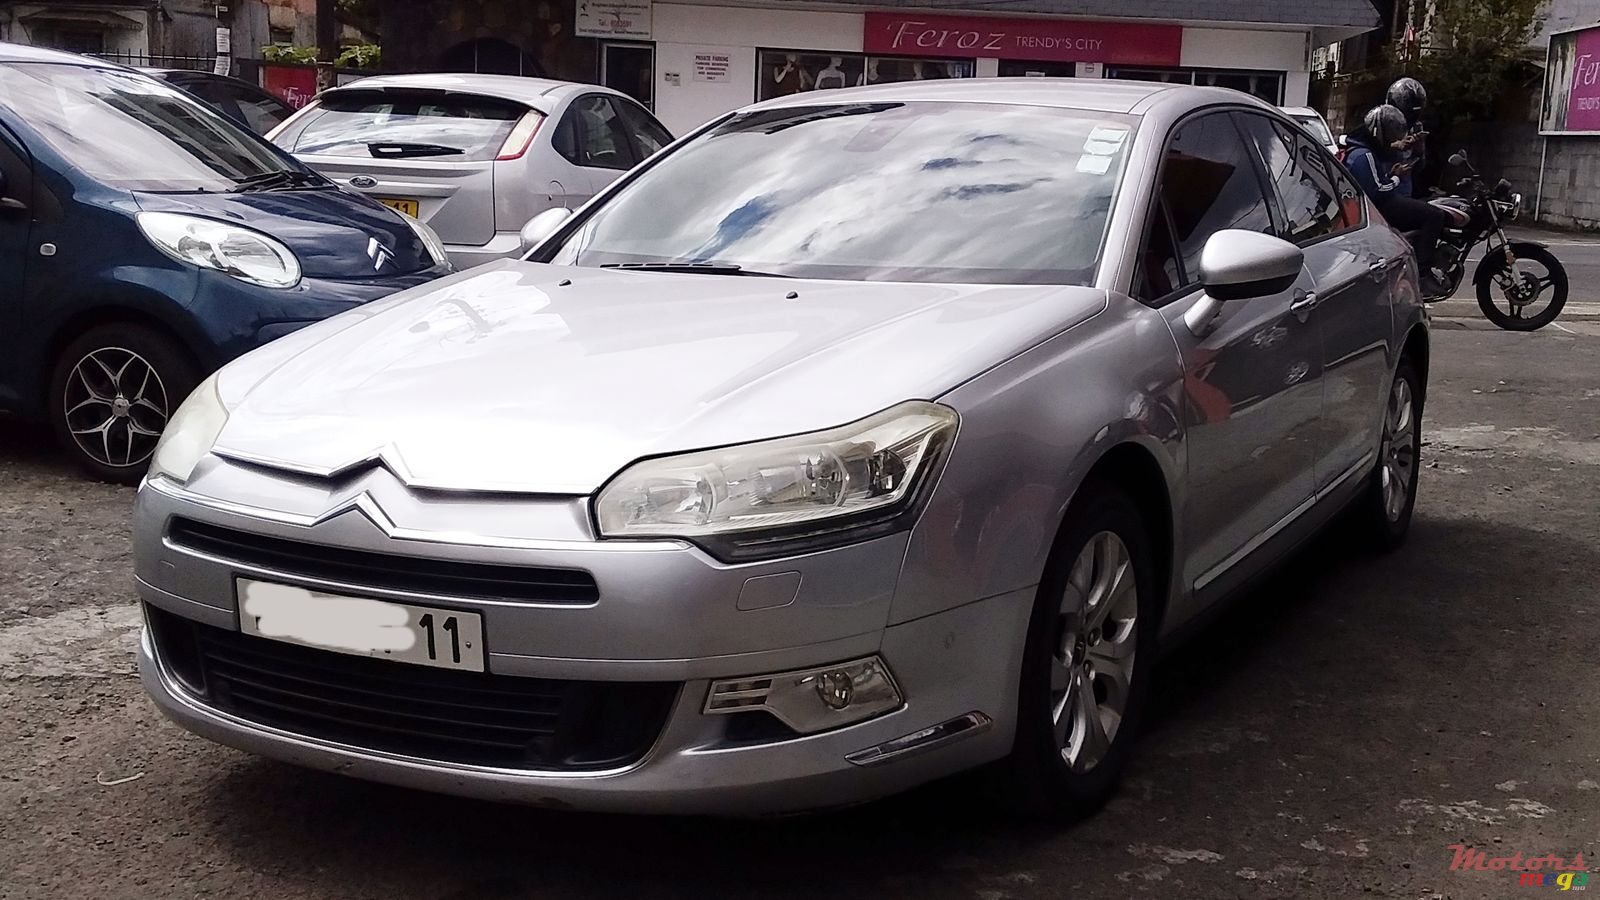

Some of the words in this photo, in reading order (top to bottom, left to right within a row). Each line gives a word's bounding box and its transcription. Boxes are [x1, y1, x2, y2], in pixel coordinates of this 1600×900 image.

[886, 21, 1006, 51] Feroz
[1016, 36, 1072, 49] TRENDY'S
[1076, 38, 1103, 50] CITY
[419, 613, 460, 664] 11
